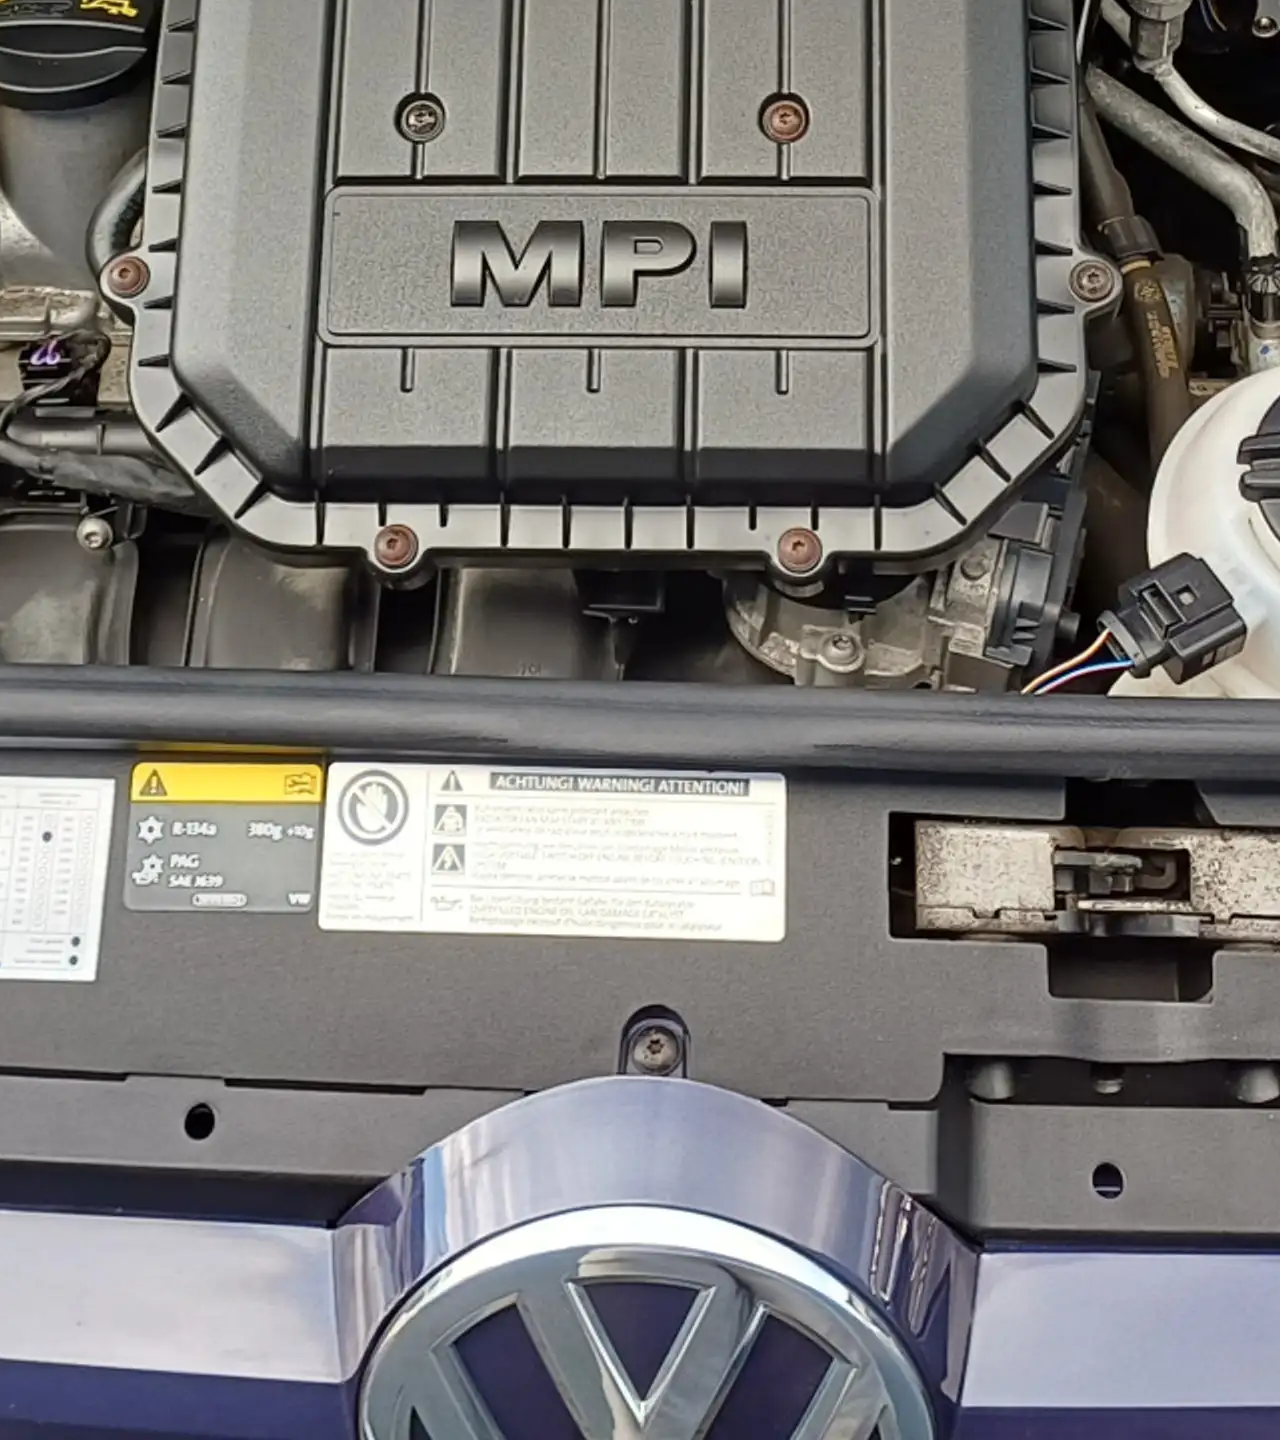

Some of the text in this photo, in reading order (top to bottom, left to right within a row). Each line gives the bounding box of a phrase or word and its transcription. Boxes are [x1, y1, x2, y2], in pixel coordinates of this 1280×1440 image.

[448, 218, 749, 310] MPI
[495, 774, 744, 796] ACHTUNG! WARNING! ATTENTION!
[169, 853, 201, 869] PAG
